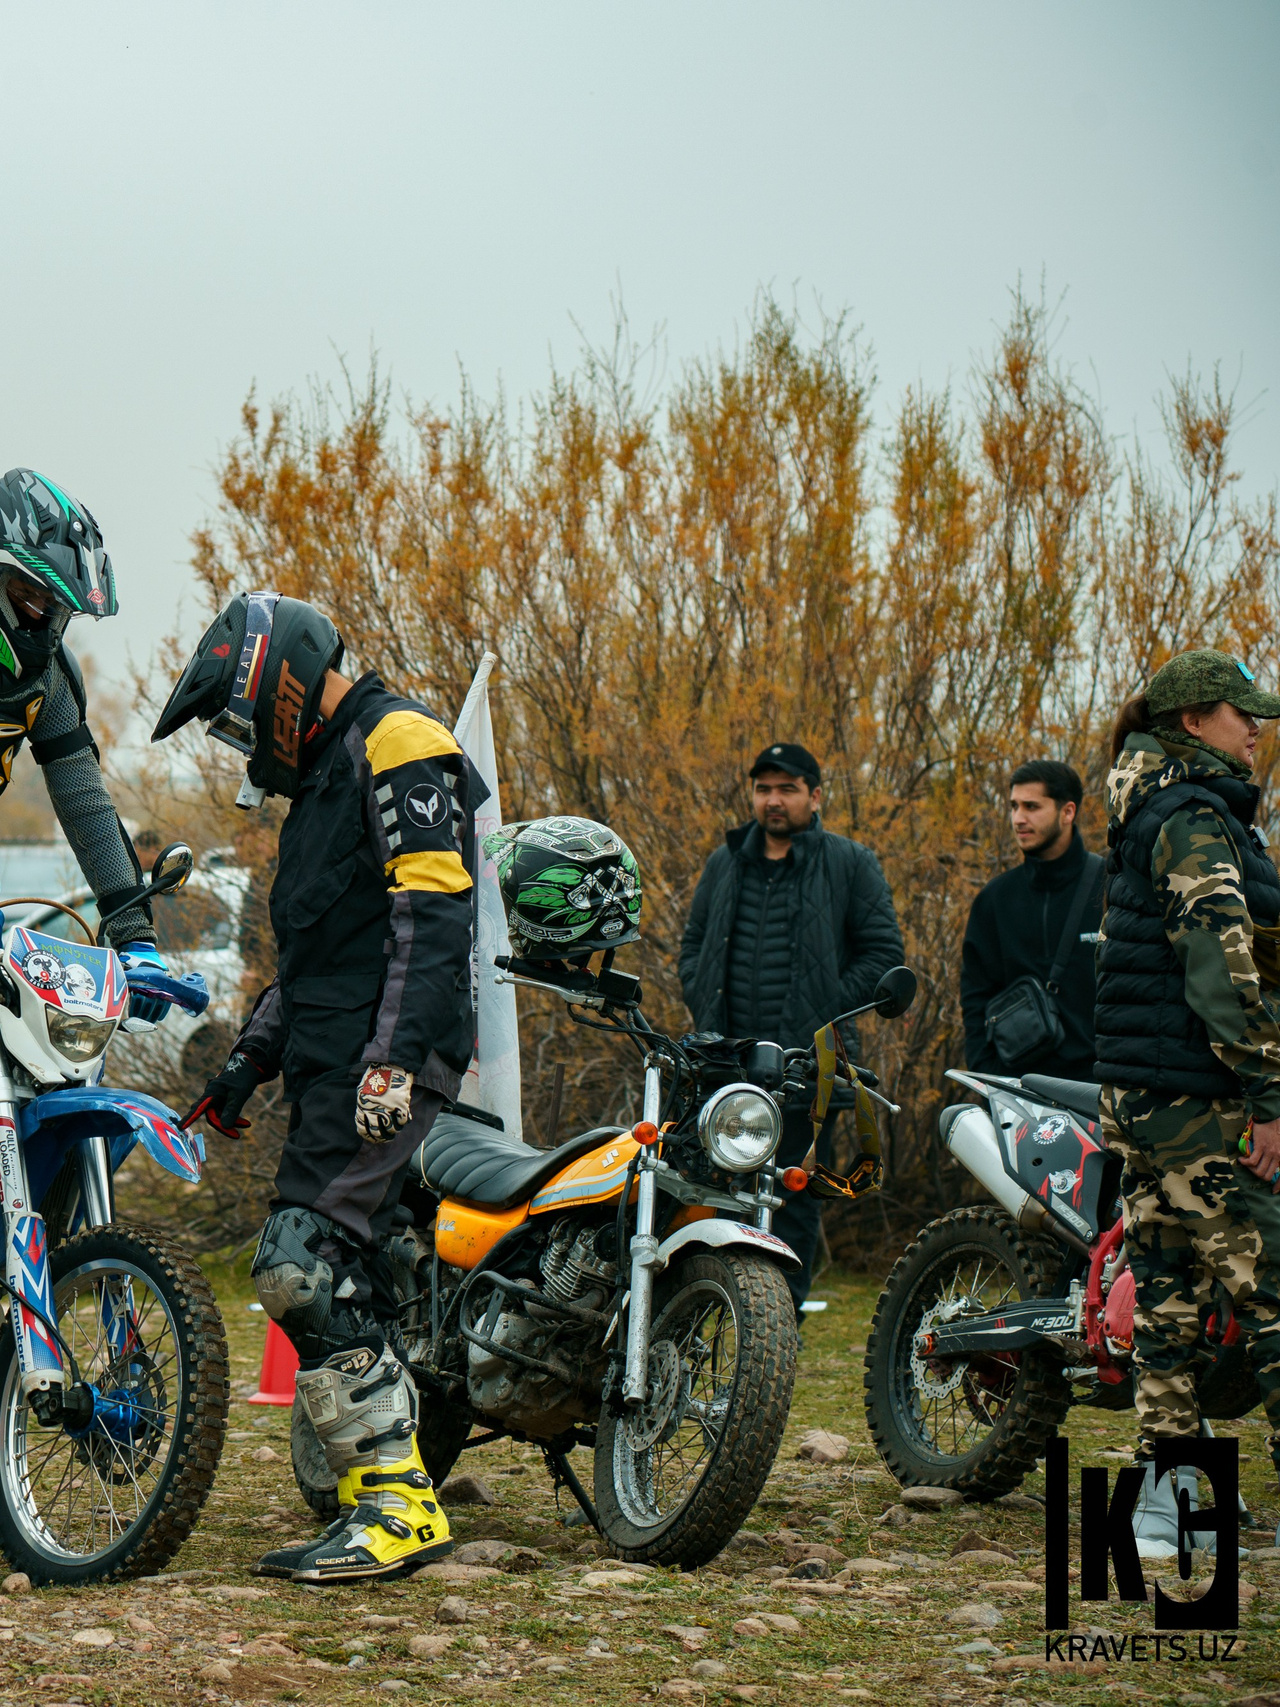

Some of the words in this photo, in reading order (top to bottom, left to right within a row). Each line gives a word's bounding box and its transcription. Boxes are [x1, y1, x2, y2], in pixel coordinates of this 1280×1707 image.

[233, 631, 257, 699] LEATT
[273, 658, 306, 768] LEATT
[41, 943, 104, 969] MONSTER
[40, 970, 50, 982] 9
[6, 1129, 16, 1153] FULLY
[0, 1140, 11, 1177] LOADED
[1056, 1204, 1085, 1228] NC300
[9, 1274, 26, 1373] btmotors
[416, 1523, 436, 1544] G
